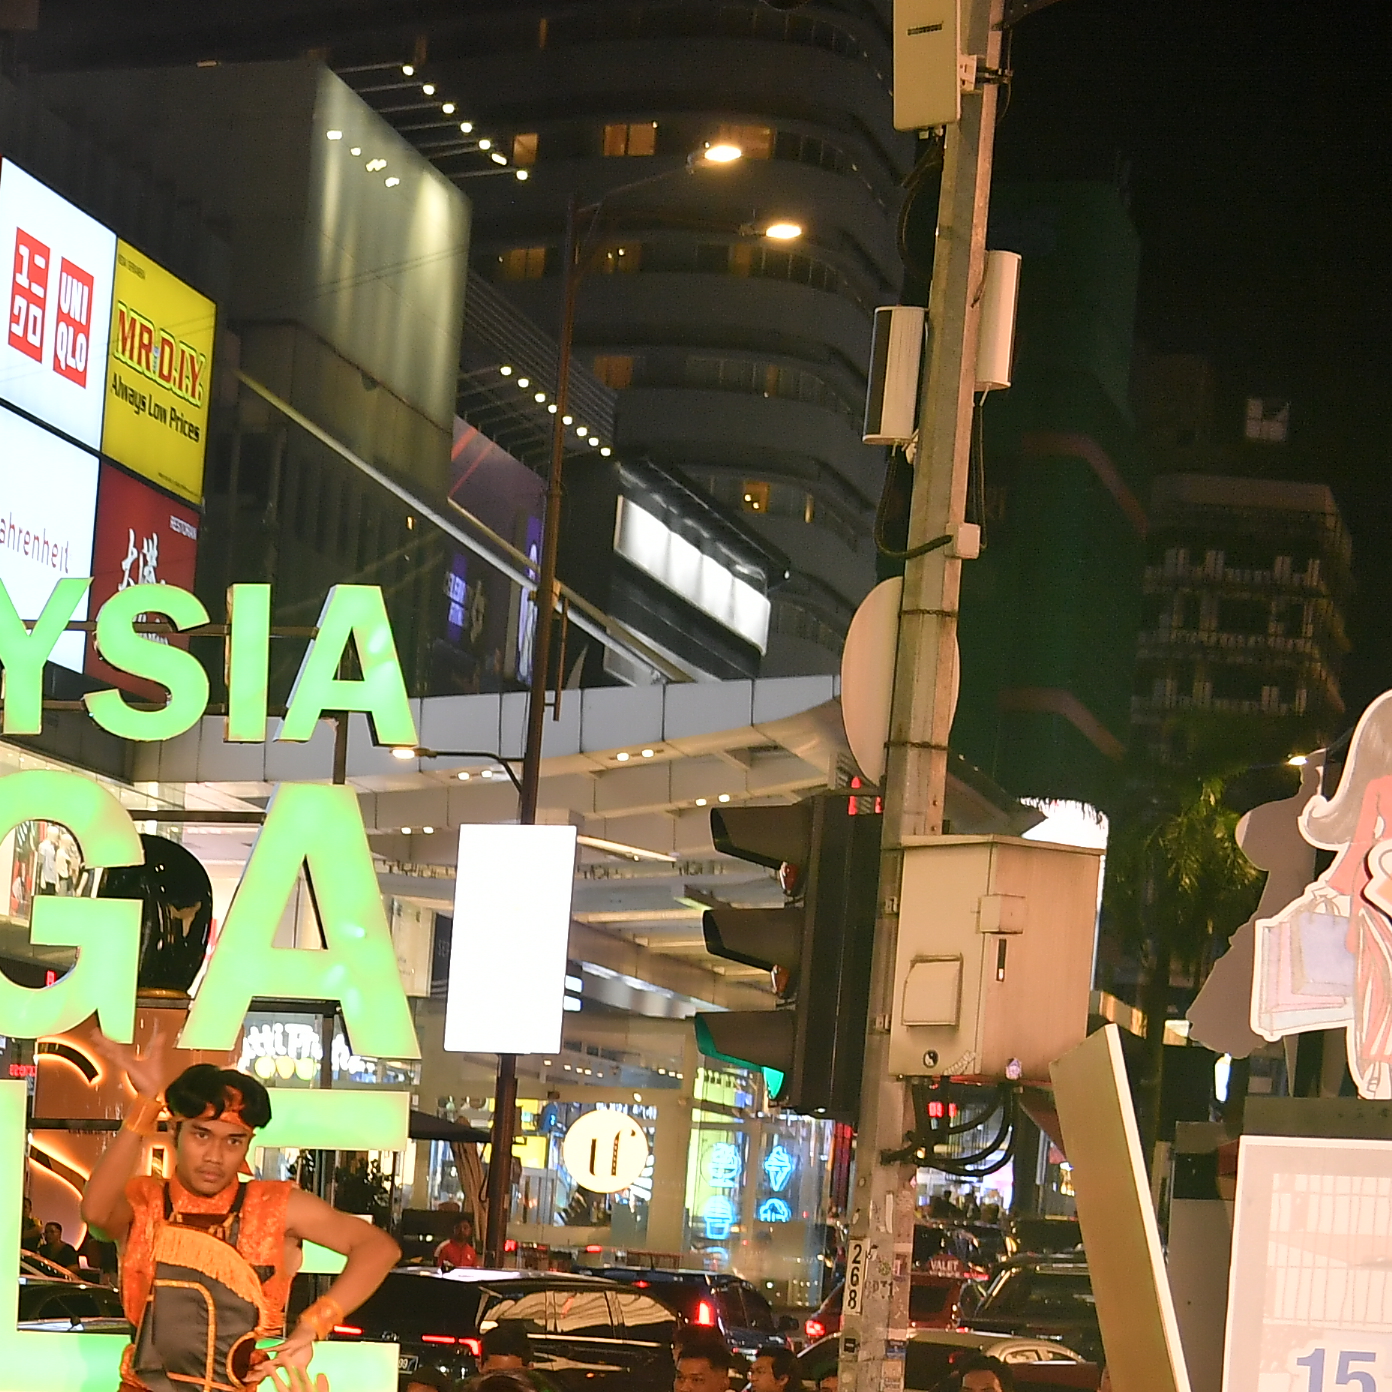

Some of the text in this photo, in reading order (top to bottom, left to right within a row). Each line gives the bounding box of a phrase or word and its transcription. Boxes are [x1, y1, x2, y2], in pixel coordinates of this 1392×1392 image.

[59, 271, 89, 327] UNI
[56, 320, 88, 375] QLO
[112, 371, 200, 443] Always Low Prices
